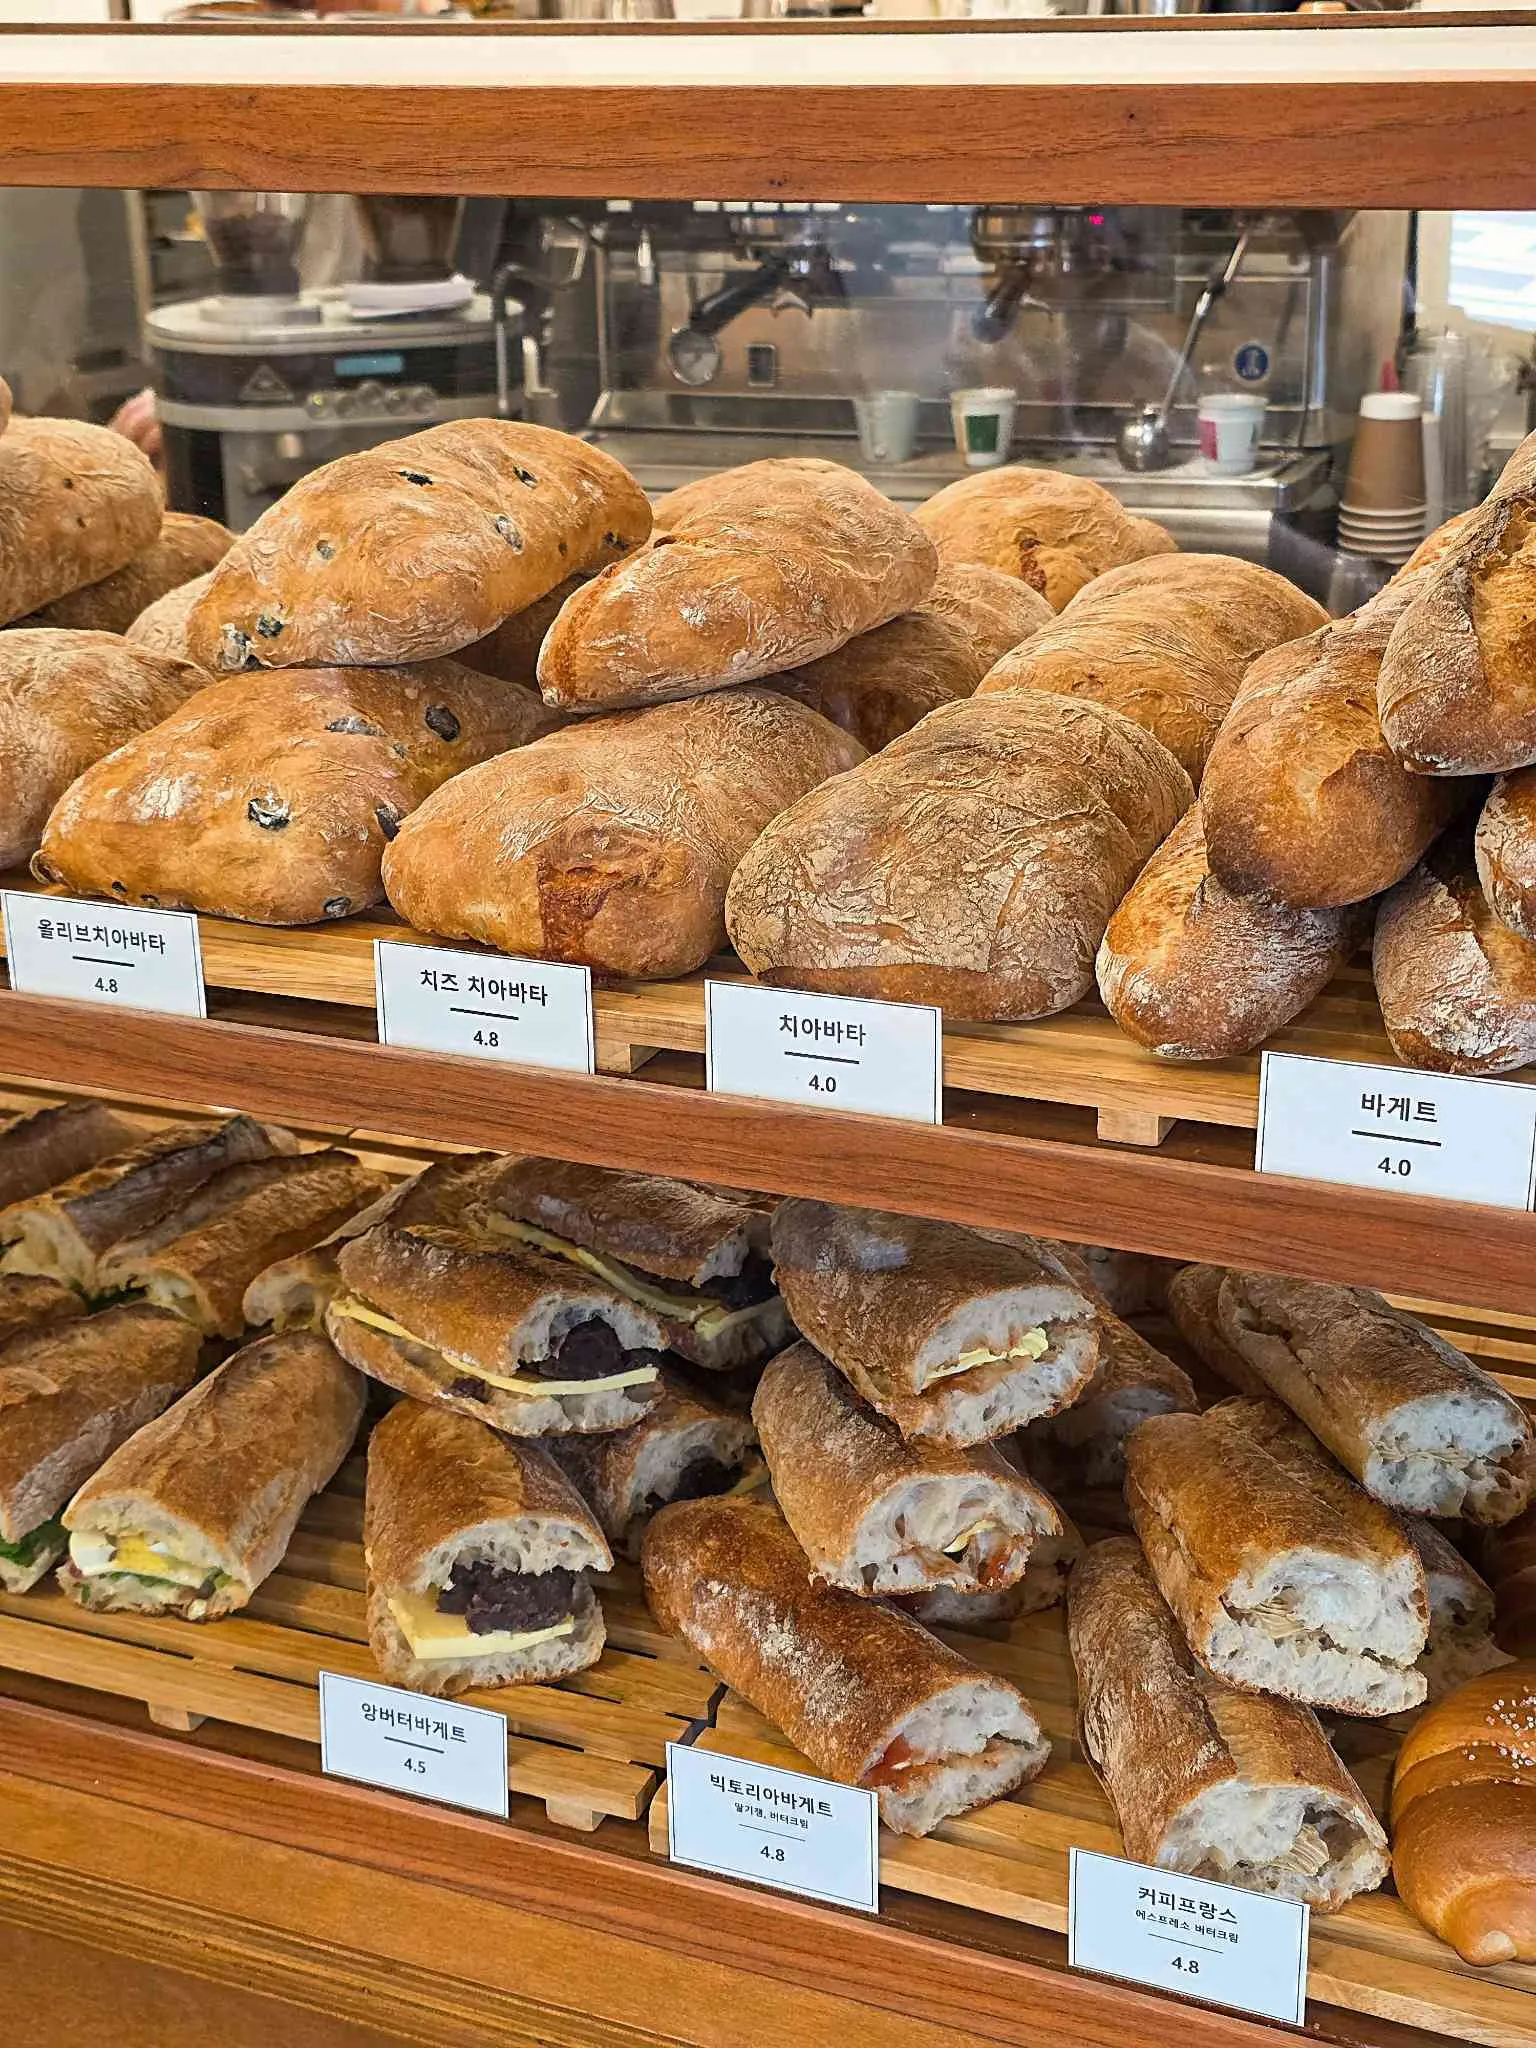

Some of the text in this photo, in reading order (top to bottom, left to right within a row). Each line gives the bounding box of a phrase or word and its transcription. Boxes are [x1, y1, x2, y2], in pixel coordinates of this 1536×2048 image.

[37, 918, 166, 955] 올리브치아바타
[94, 977, 119, 994] 4.8
[420, 969, 549, 1007] 치즈 치아바타
[473, 1030, 499, 1047] 4.8
[778, 1014, 867, 1046] 치아바타
[808, 1074, 837, 1093] 4.0
[1361, 1093, 1438, 1123] 바게트
[1377, 1157, 1412, 1177] 4.0
[361, 1702, 467, 1743] 앙버터바게트
[403, 1757, 426, 1774] 4.5
[709, 1773, 833, 1818] 빅토리아바게트
[759, 1845, 786, 1862] 4.8
[1138, 1886, 1239, 1925] 커피프랑스
[1135, 1909, 1239, 1943] 에스프레소 버터크림
[1171, 1956, 1200, 1974] 4.8
